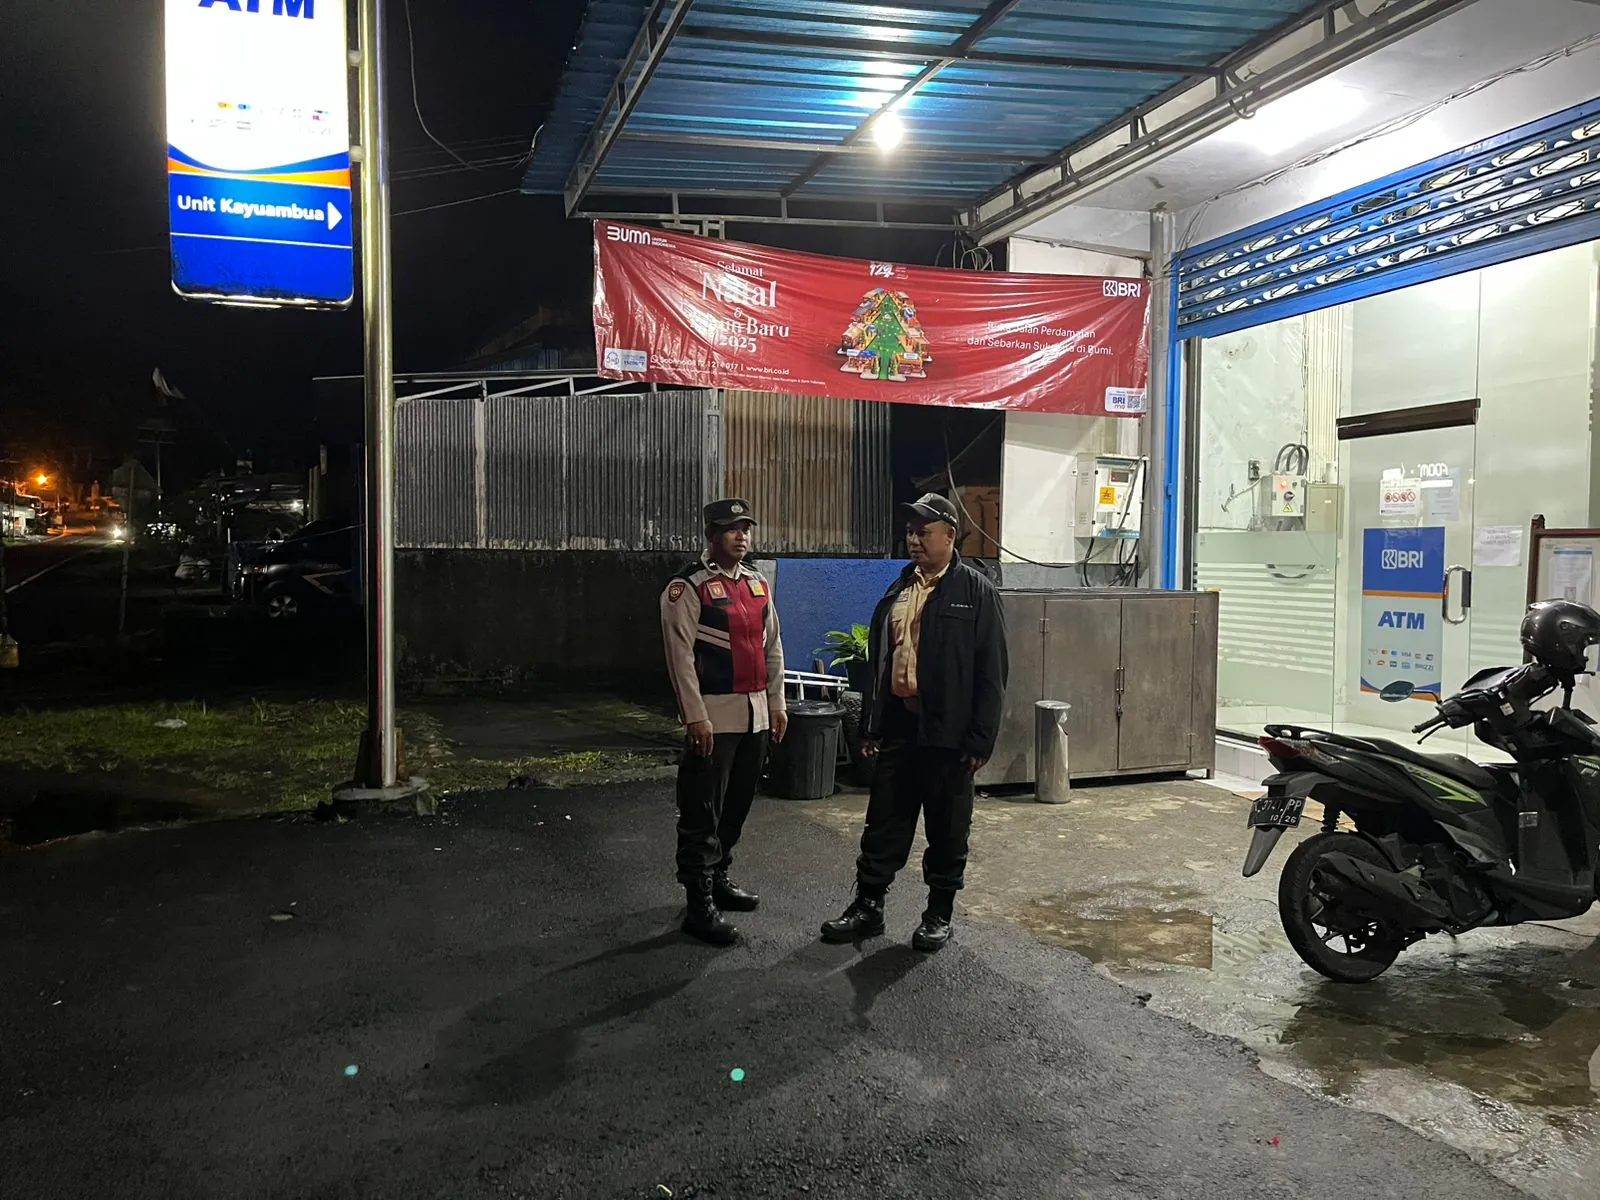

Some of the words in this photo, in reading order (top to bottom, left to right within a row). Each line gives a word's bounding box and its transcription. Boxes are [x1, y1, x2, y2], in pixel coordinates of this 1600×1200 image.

[177, 195, 216, 212] Unit
[220, 197, 325, 221] Kayuambua
[607, 225, 650, 245] BUMN
[717, 256, 763, 277] Selamat
[702, 271, 777, 308] Nal
[1118, 282, 1141, 297] BRI
[746, 317, 790, 337] Baru
[1041, 325, 1096, 338] Perdamian
[718, 335, 757, 353] 2025
[967, 336, 985, 346] dan
[987, 337, 1031, 350] Sebarkan
[1076, 344, 1086, 353] di
[1112, 396, 1126, 405] BRI
[1397, 550, 1424, 569] BRI
[1378, 610, 1425, 630] ATM
